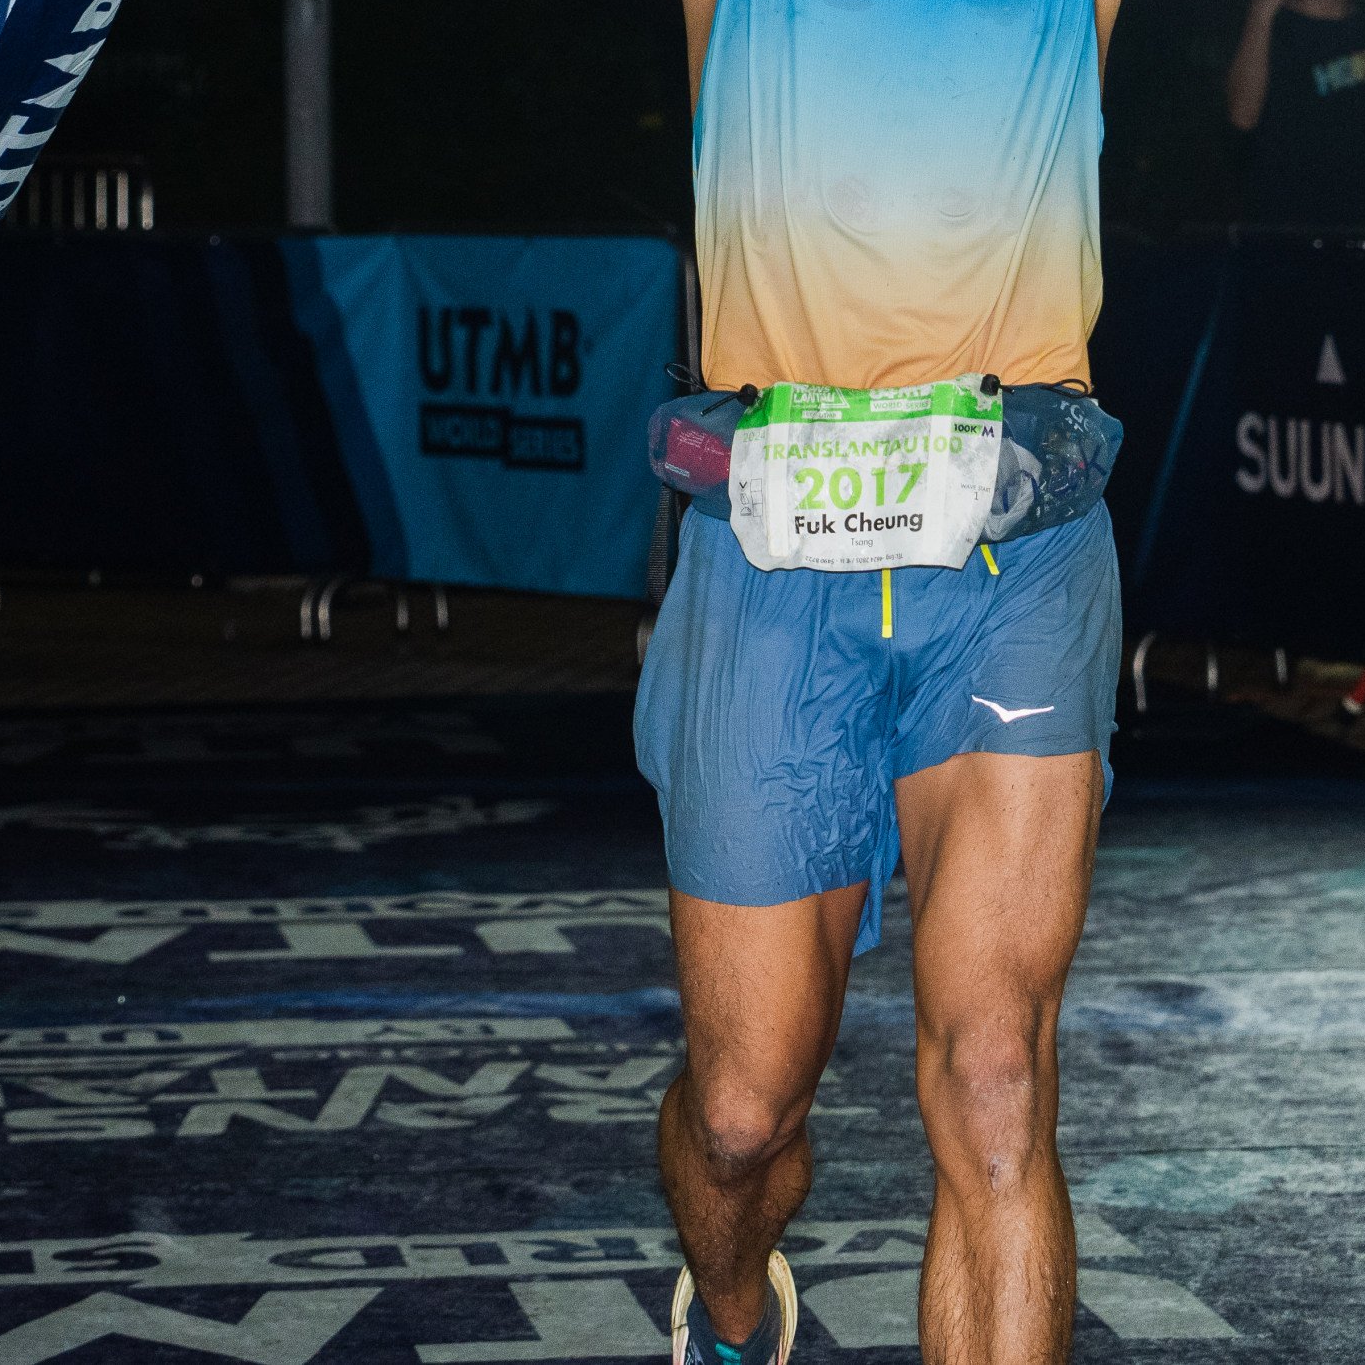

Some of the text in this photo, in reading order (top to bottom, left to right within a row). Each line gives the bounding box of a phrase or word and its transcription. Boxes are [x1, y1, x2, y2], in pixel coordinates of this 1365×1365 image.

[418, 307, 580, 394] UTMB
[794, 462, 928, 511] 2017
[794, 511, 924, 535] Fuk Cheung
[851, 538, 874, 547] Tsang
[7, 1090, 665, 1144] RANS
